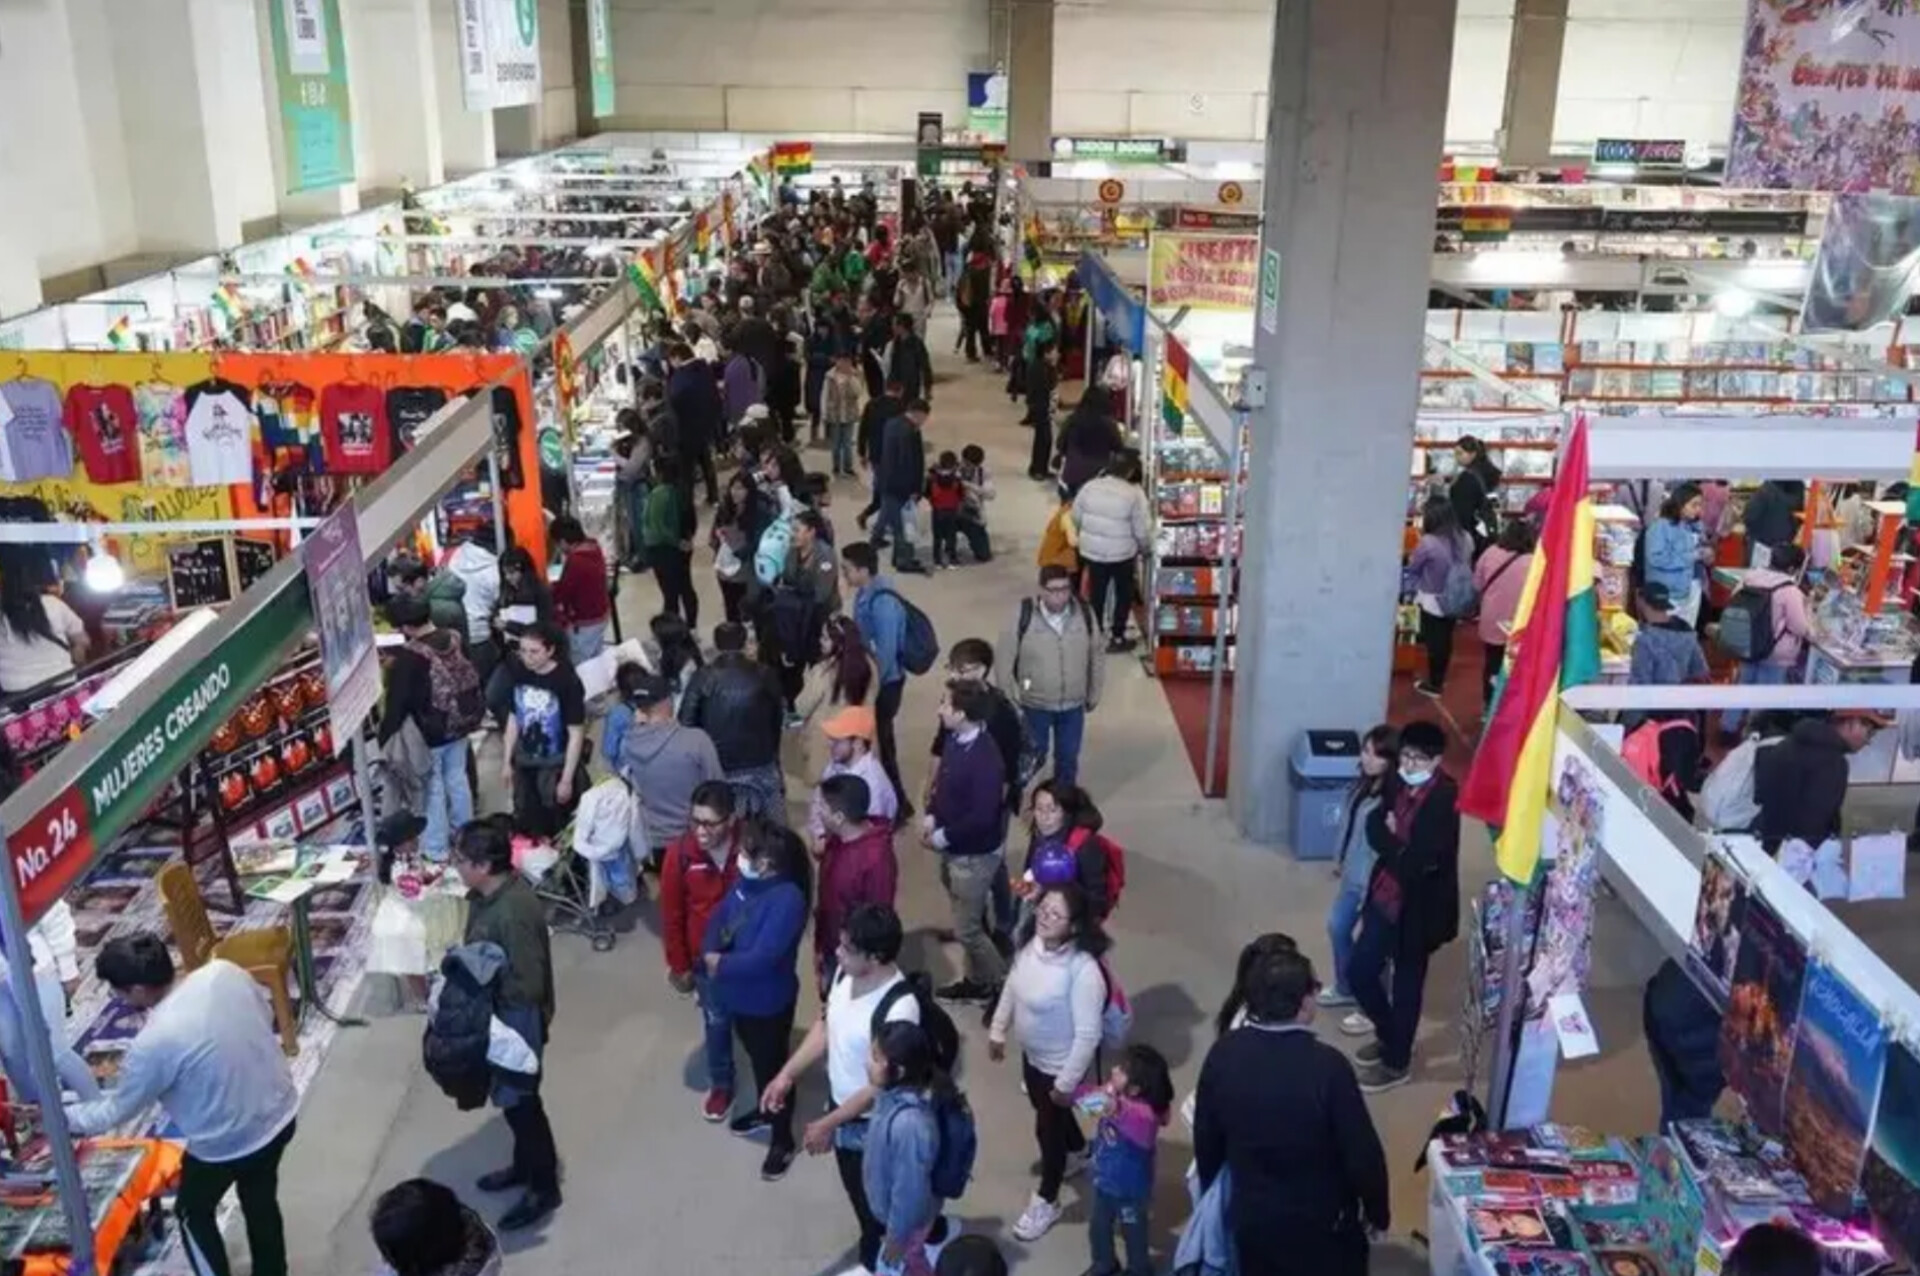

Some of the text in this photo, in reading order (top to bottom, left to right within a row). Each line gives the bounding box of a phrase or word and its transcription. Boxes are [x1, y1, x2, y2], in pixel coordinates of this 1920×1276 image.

[16, 847, 49, 889] No.
[47, 807, 79, 857] 24
[91, 729, 165, 816] MUJERES
[164, 663, 230, 741] CREANDO
